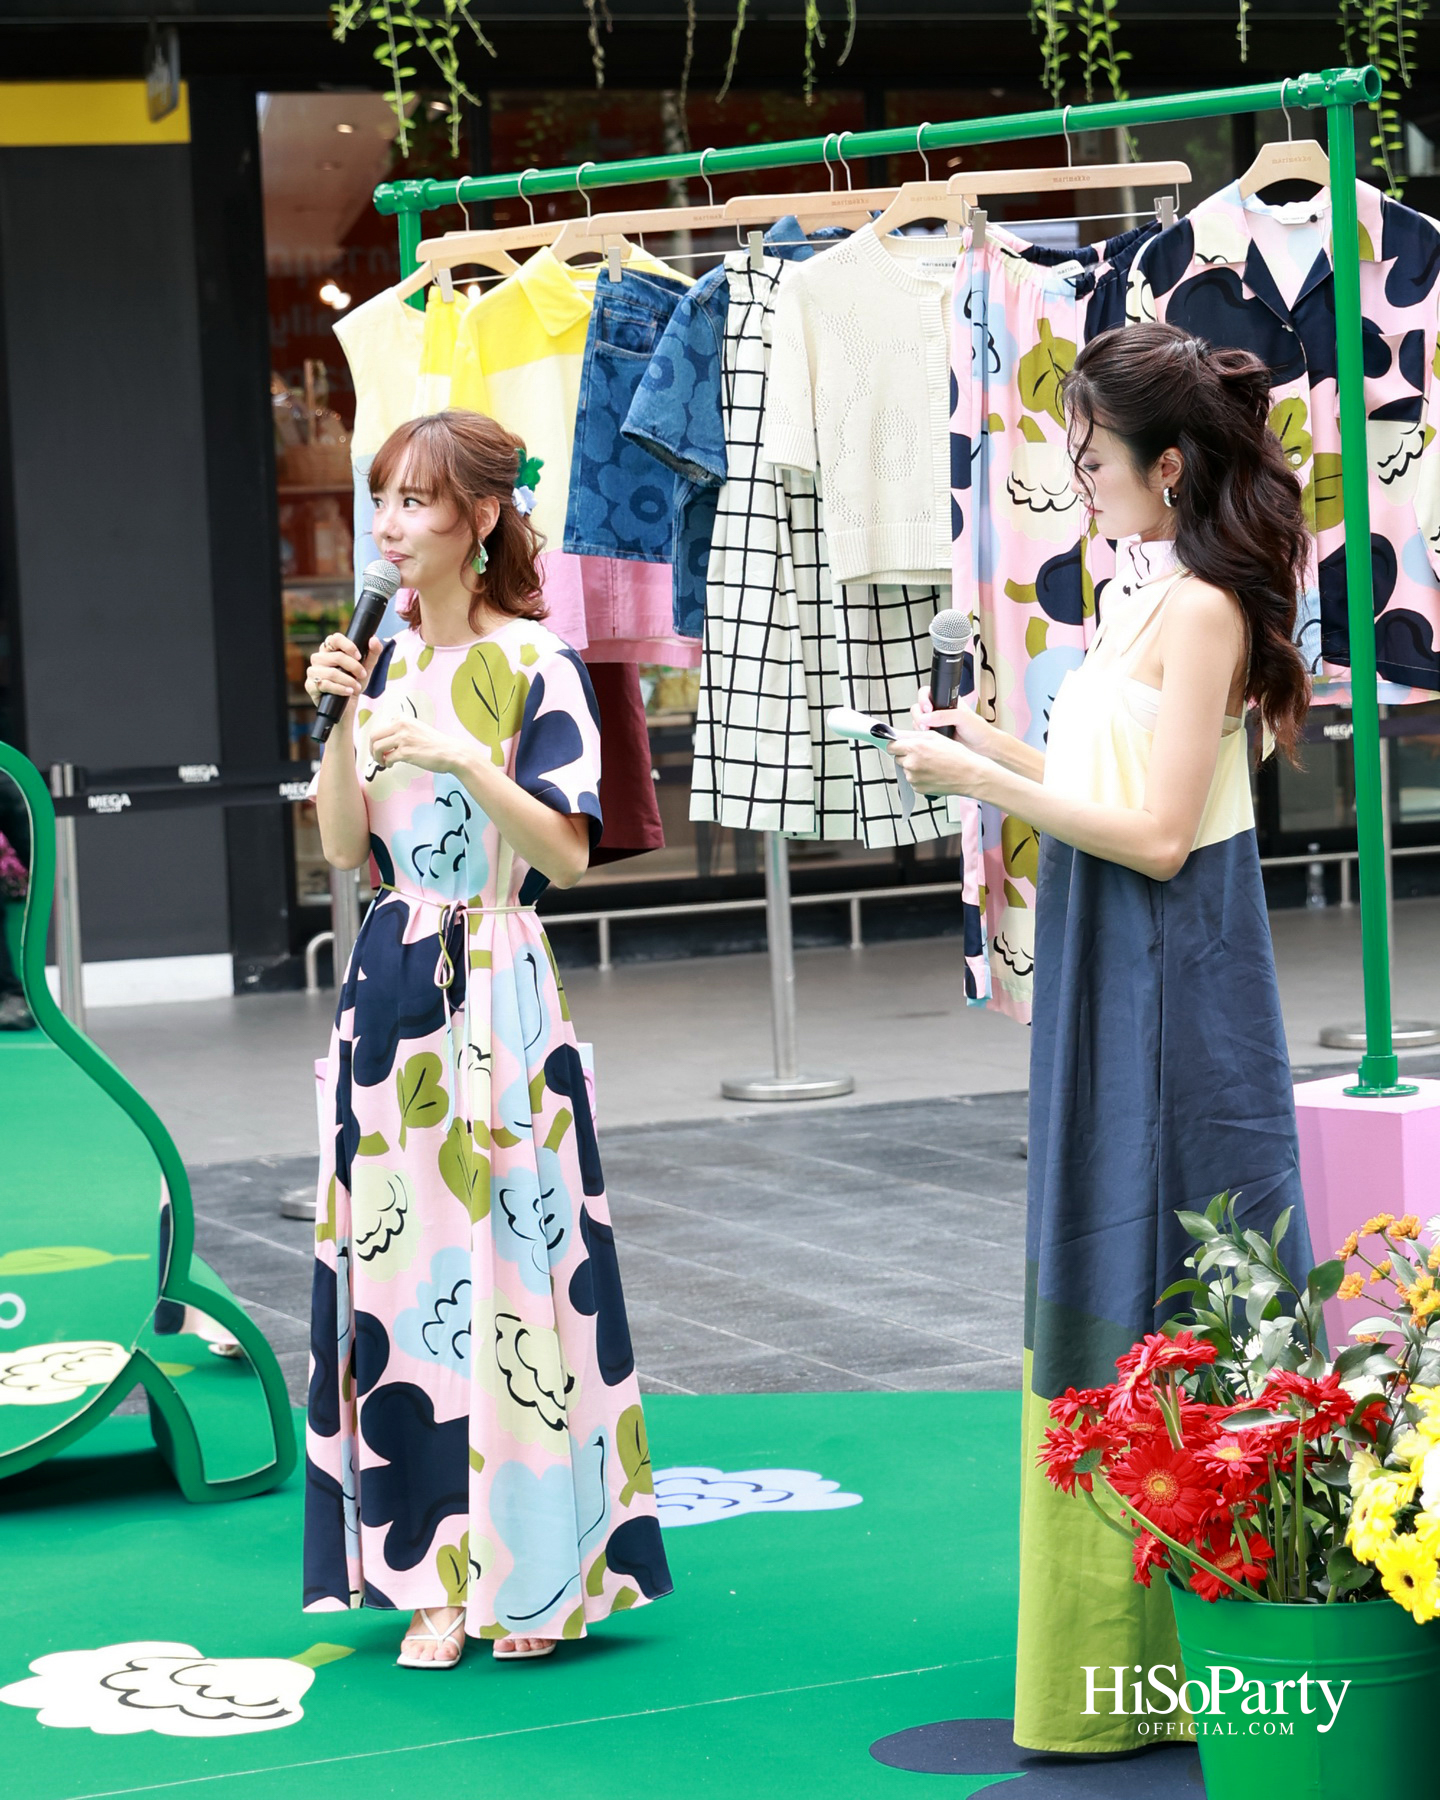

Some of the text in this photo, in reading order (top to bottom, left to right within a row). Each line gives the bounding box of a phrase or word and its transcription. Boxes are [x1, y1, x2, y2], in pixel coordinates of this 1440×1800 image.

[1052, 174, 1091, 183] marimekko
[178, 764, 219, 781] MEGA
[279, 781, 310, 797] MEG
[87, 793, 132, 810] MEGA
